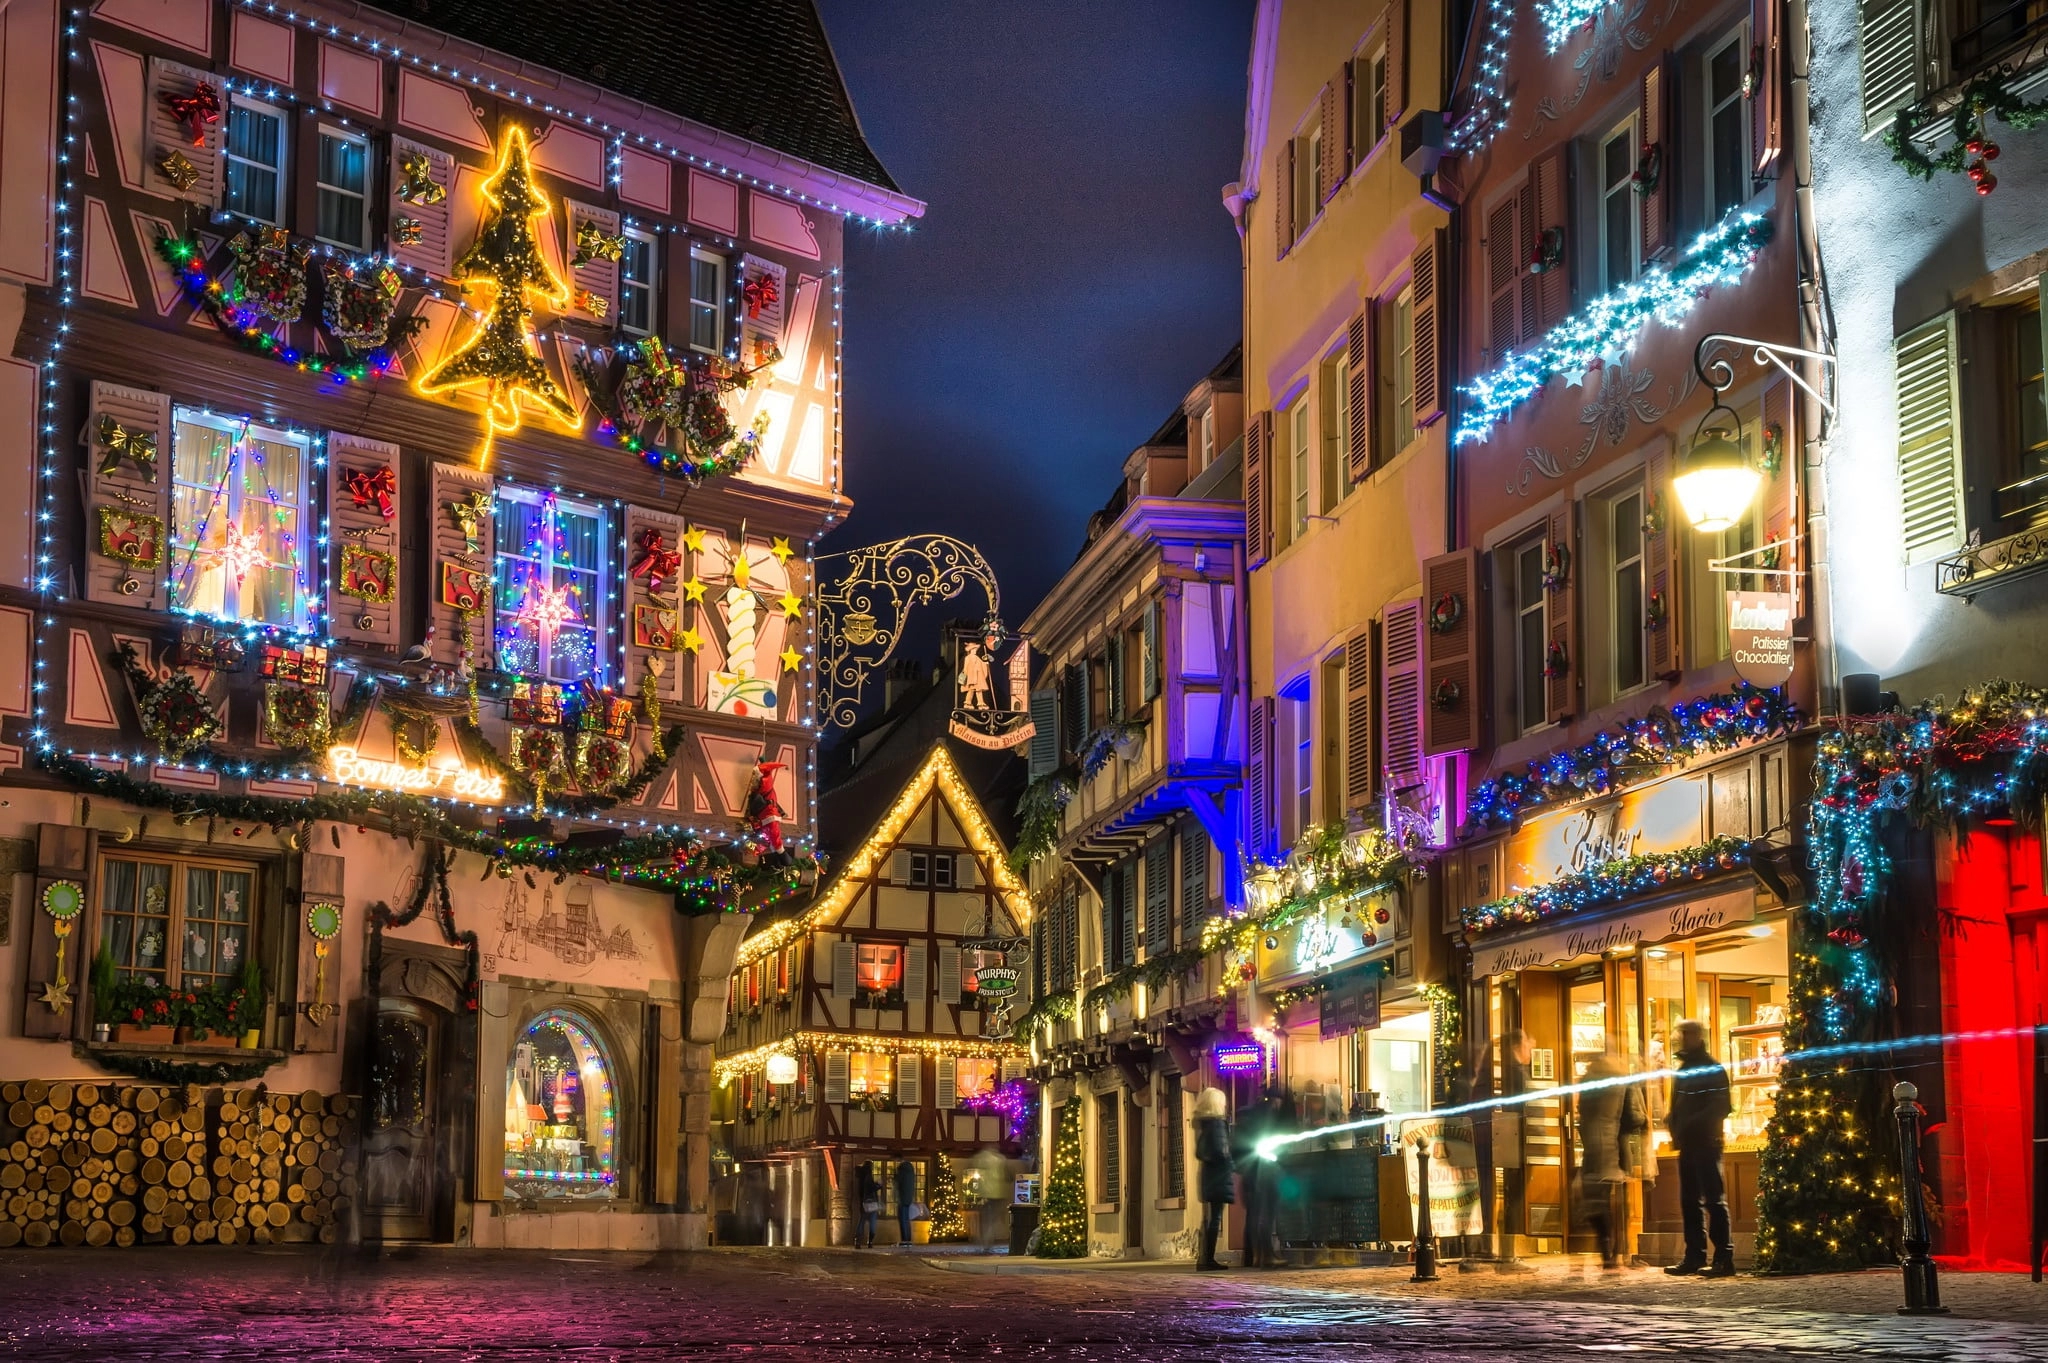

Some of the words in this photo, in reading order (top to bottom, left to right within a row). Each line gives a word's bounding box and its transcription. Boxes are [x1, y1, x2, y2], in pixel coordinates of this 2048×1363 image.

[1735, 649, 1790, 665] Chocolatier
[955, 727, 986, 747] Maison
[988, 739, 999, 747] au
[329, 746, 432, 788] Bonnes
[1491, 950, 1545, 973] Pâtissier
[1566, 922, 1643, 957] Chocolatier
[1669, 907, 1727, 935] Glacier
[978, 988, 995, 996] IRISH
